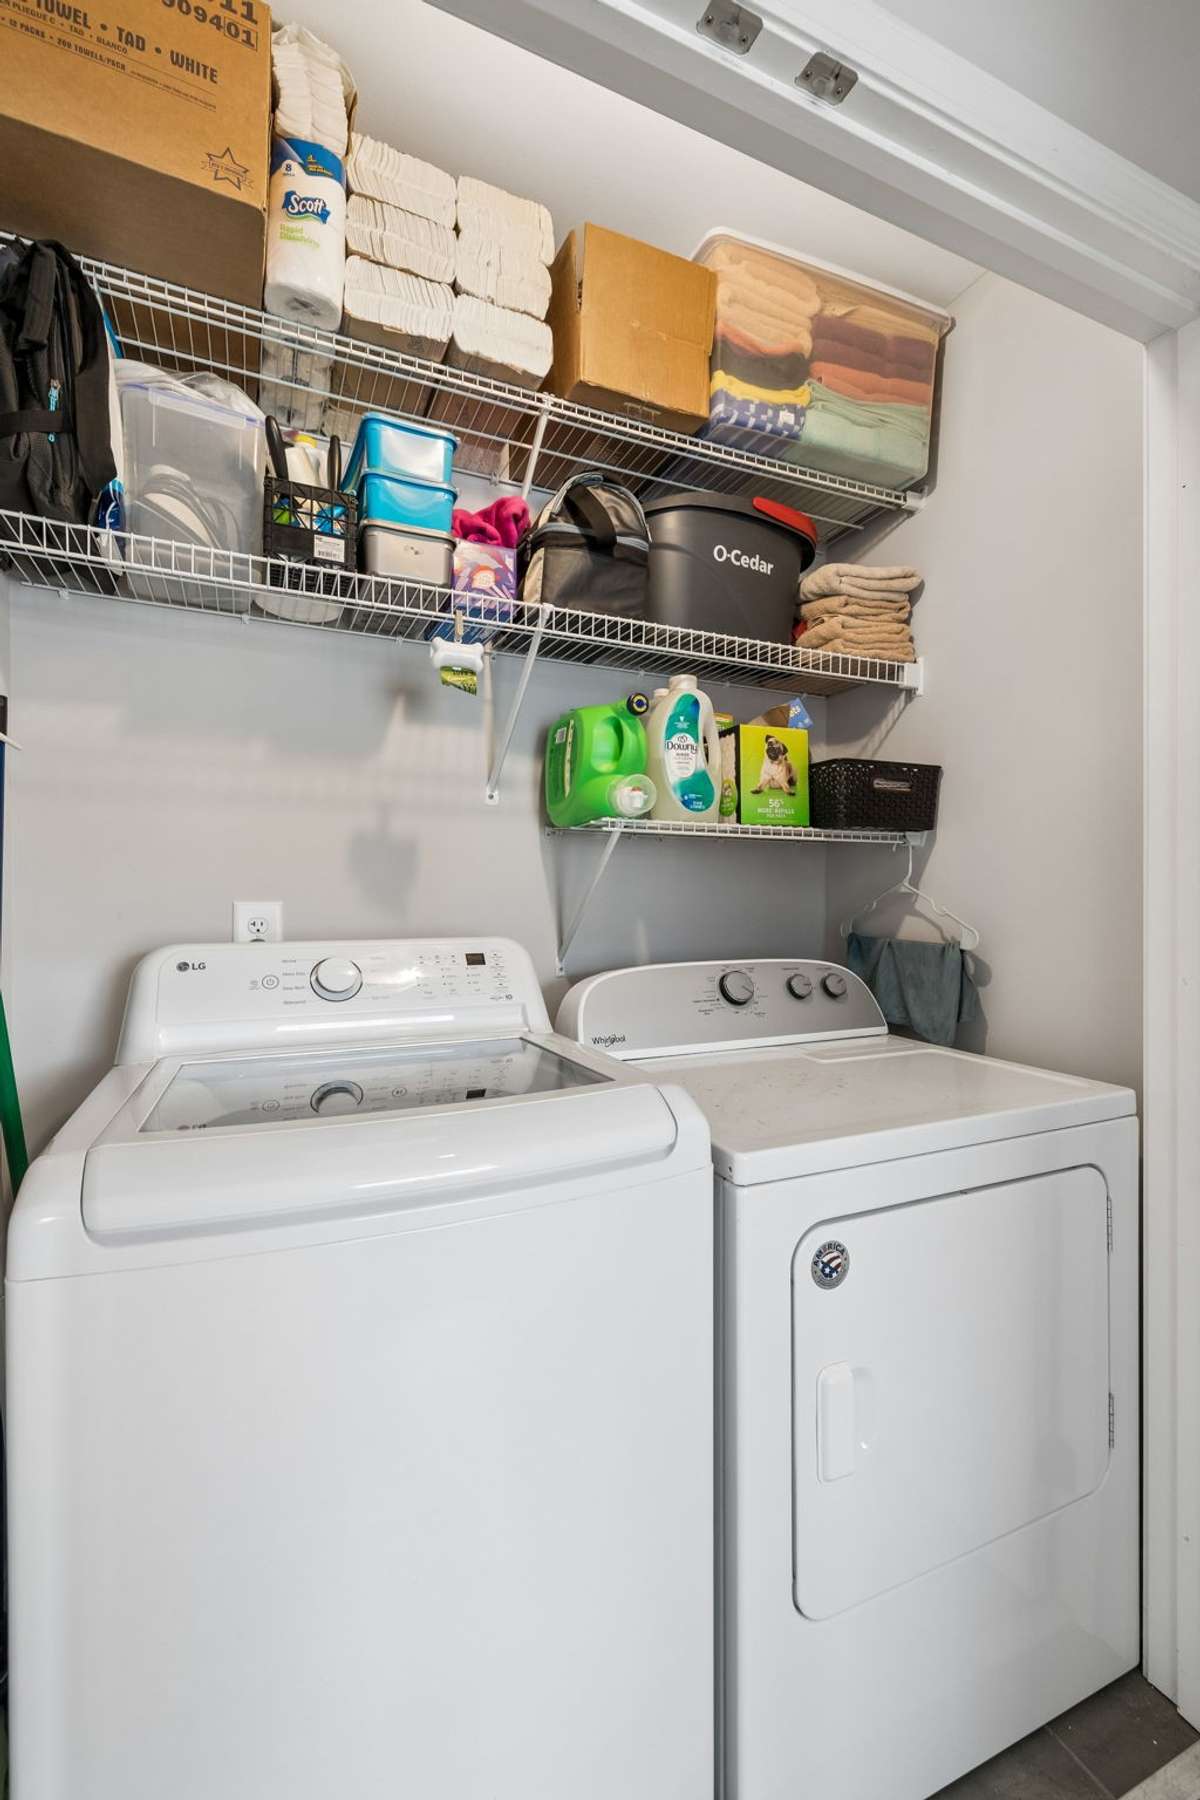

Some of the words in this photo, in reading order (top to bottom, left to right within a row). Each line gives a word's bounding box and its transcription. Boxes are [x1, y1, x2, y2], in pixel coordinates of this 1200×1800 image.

[116, 25, 146, 52] TAD
[169, 49, 219, 85] WHITE
[288, 194, 324, 214] Scott
[666, 740, 698, 755] Downy
[191, 962, 207, 971] LG
[591, 1034, 627, 1048] Whirlpool
[813, 1242, 846, 1268] AMERICA
